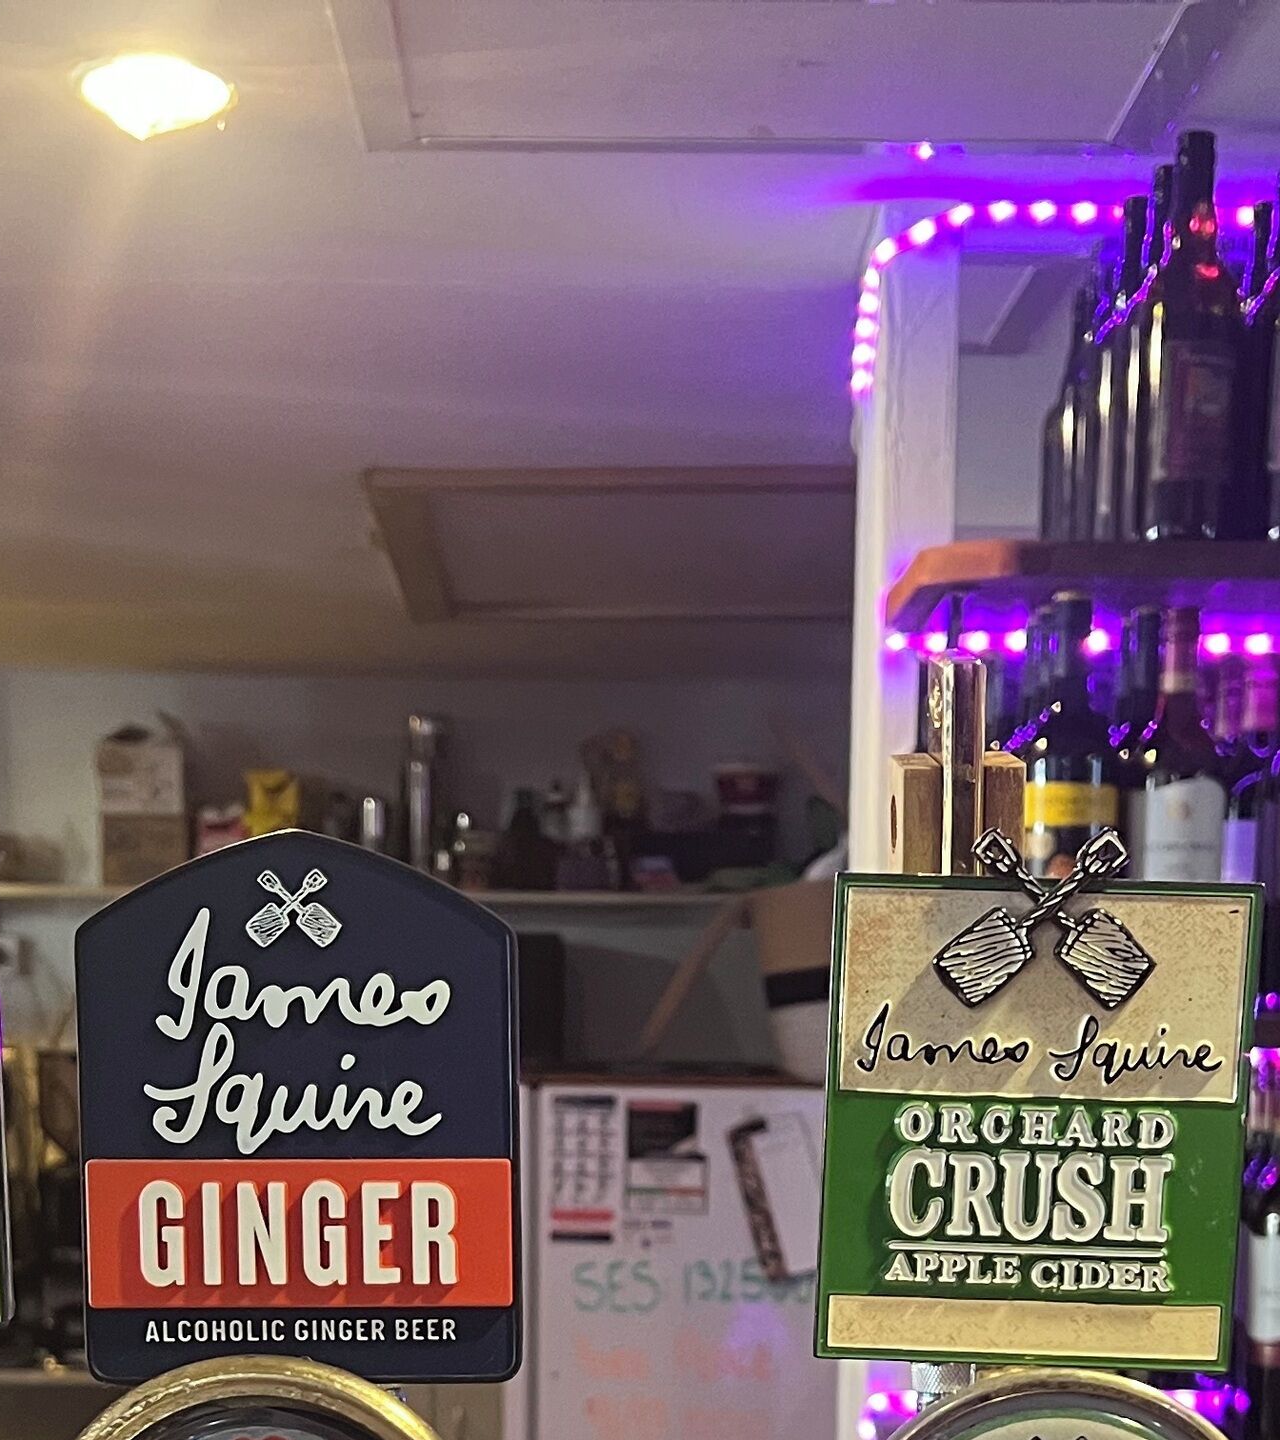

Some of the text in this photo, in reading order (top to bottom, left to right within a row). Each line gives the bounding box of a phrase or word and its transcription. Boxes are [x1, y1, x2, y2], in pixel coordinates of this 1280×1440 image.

[154, 907, 452, 1040] James
[143, 1021, 443, 1155] Squire
[856, 1002, 1223, 1086] James Squire
[895, 1101, 1177, 1150] ORCHARD
[138, 1179, 459, 1288] GINGER
[886, 1147, 1174, 1244] CRUSH
[884, 1252, 1172, 1293] APPLE CIDER
[145, 1317, 457, 1344] ALCOHOLIC GINGER BEER
